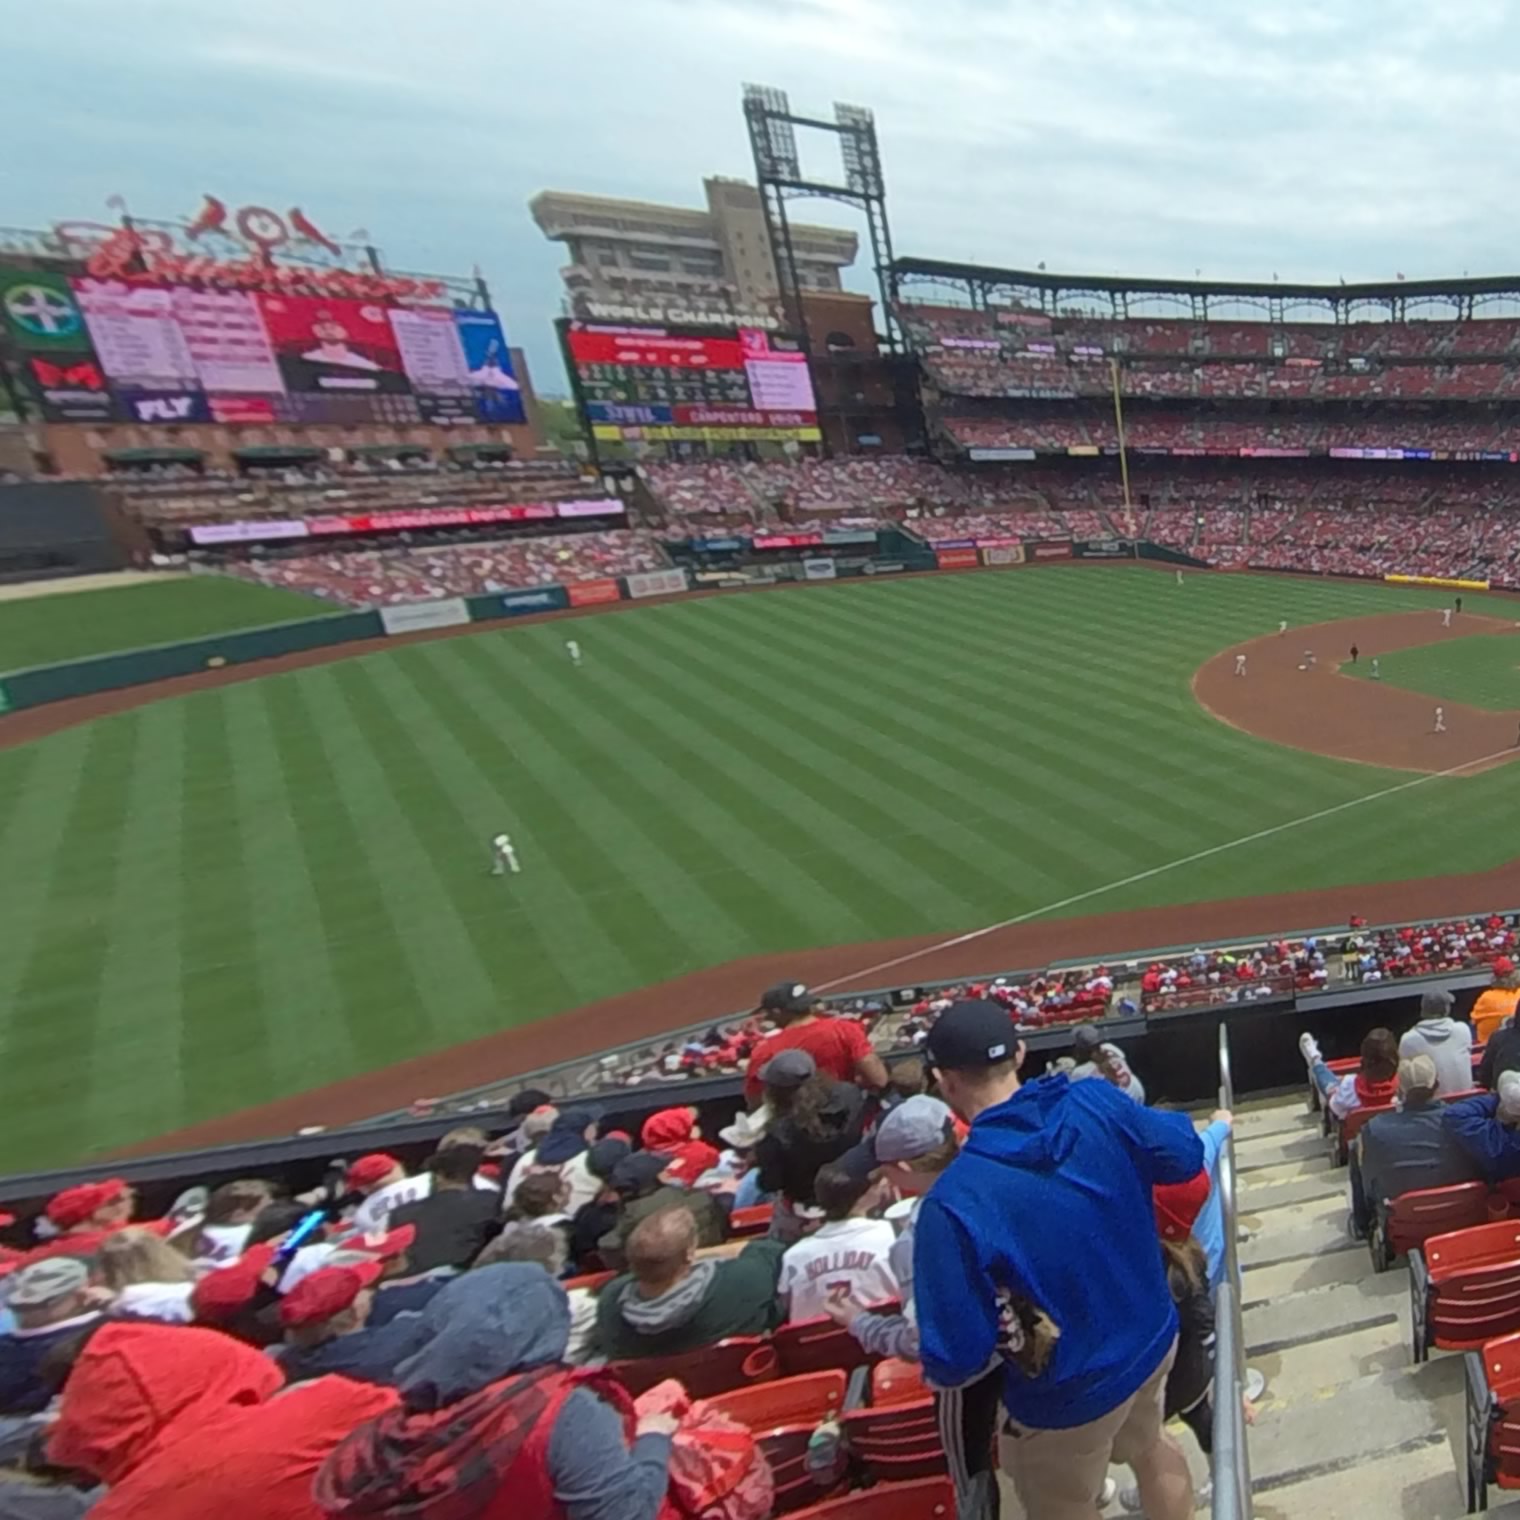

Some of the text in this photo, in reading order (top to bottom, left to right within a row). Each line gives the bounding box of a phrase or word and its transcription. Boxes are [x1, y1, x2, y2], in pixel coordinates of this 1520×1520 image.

[586, 302, 779, 329] WORLD CHAMPIONS
[804, 1250, 876, 1281] HOLLIDAY
